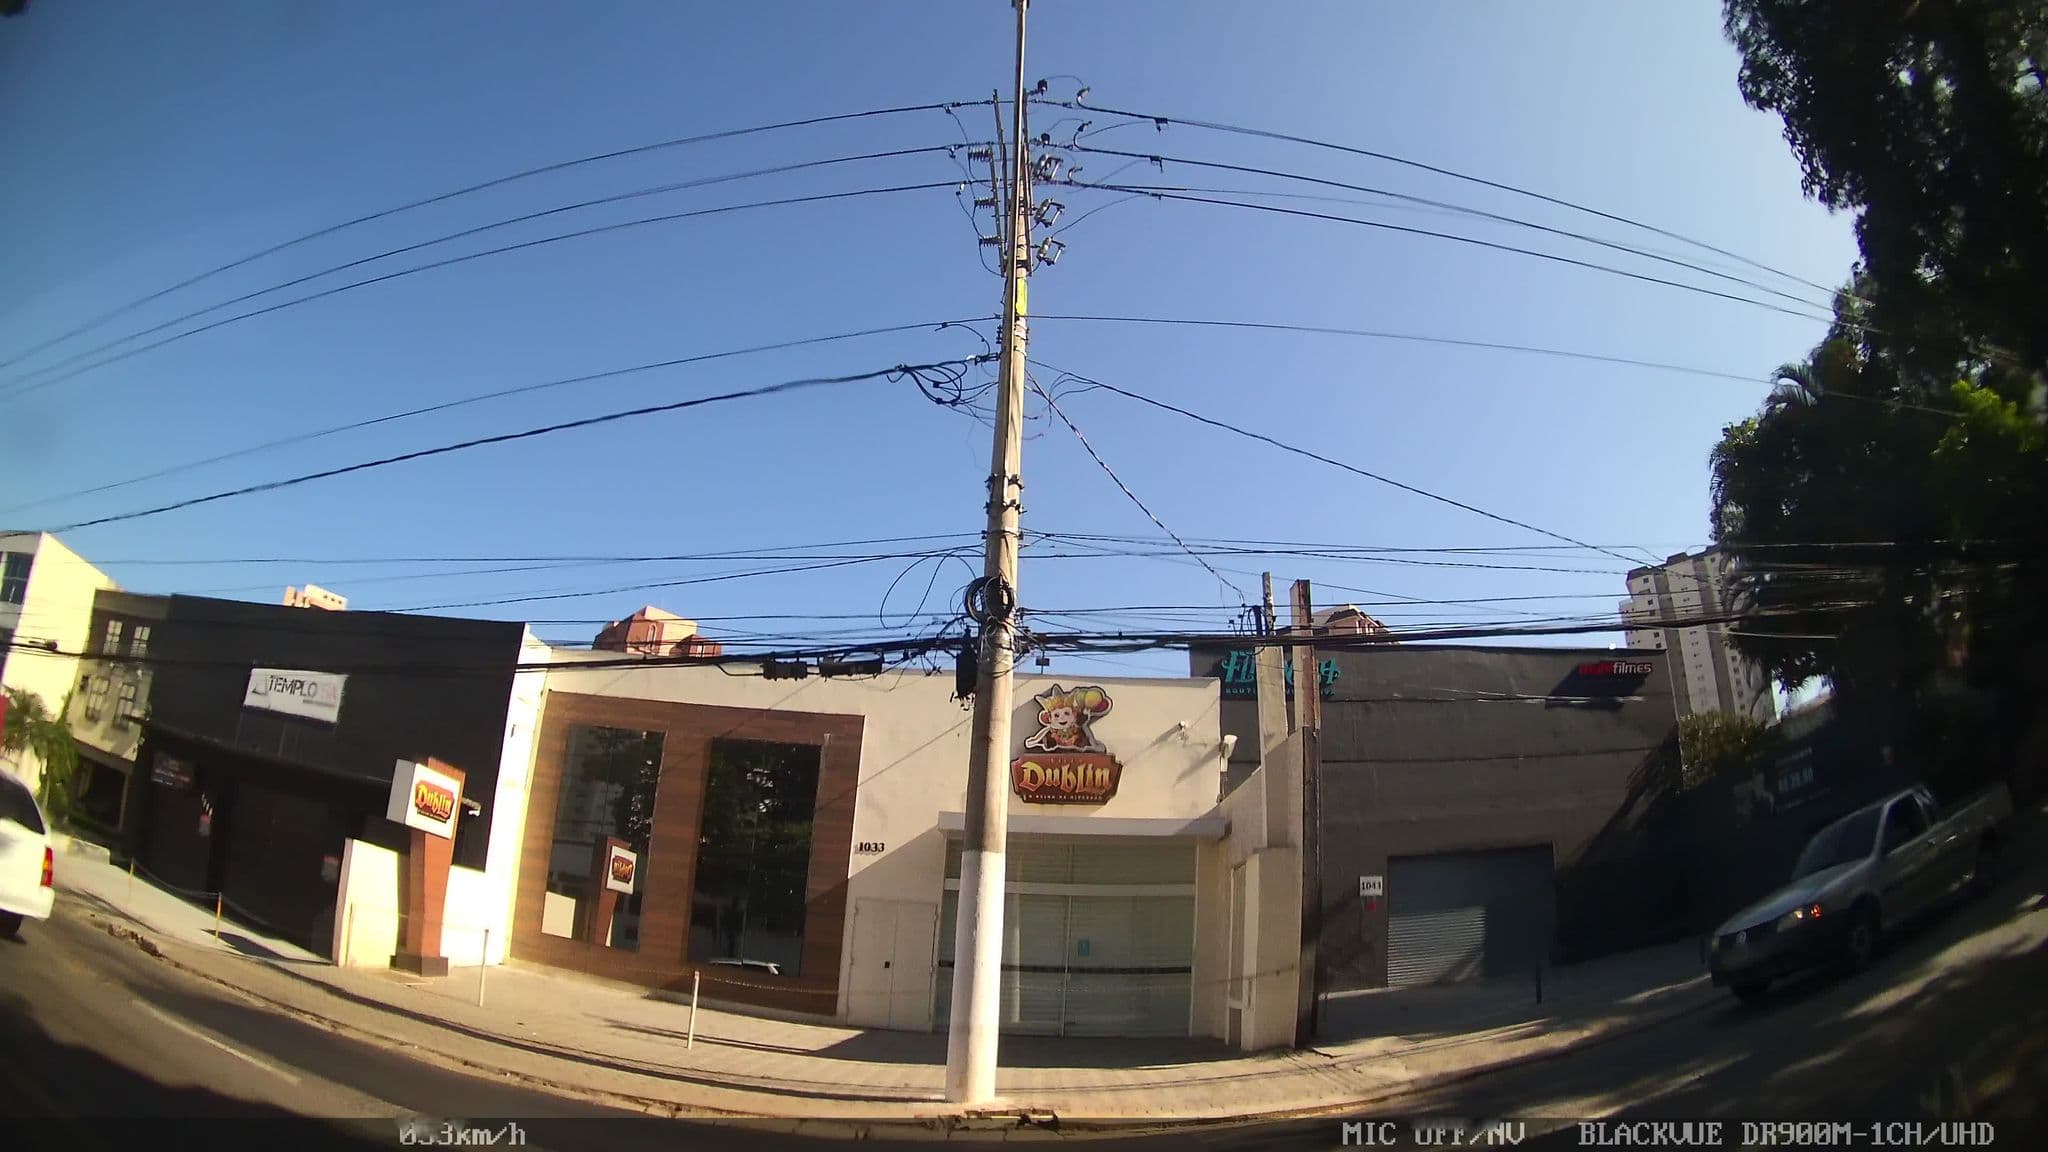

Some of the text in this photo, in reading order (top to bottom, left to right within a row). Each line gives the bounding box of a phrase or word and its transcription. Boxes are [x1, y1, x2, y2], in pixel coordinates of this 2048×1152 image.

[268, 675, 318, 698] TEMPLO
[1019, 761, 1112, 793] Dublin
[858, 841, 885, 853] 1033
